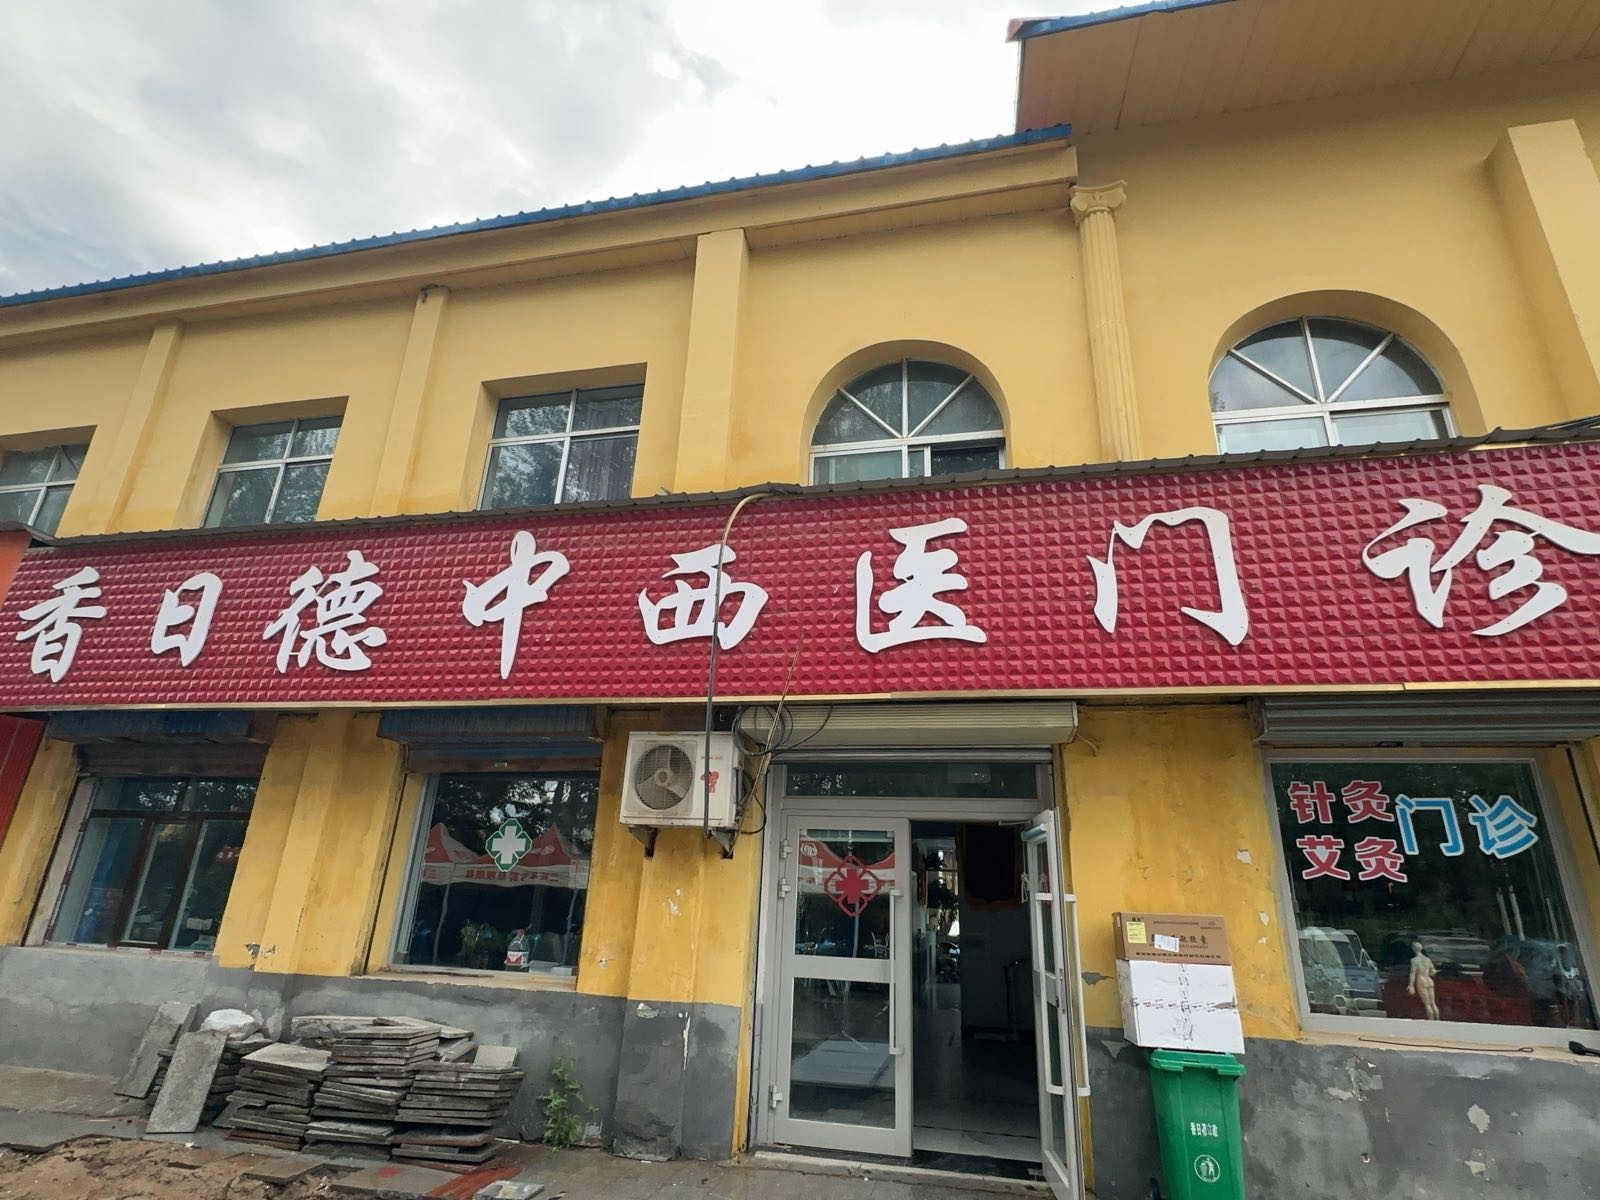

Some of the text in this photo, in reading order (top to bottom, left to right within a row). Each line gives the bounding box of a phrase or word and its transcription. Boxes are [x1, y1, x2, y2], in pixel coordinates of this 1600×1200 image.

[15, 484, 1600, 683] 香日德中西医门诊
[1288, 780, 1394, 823] 针灸
[1395, 794, 1539, 859] 门诊
[1297, 835, 1407, 882] 艾灸
